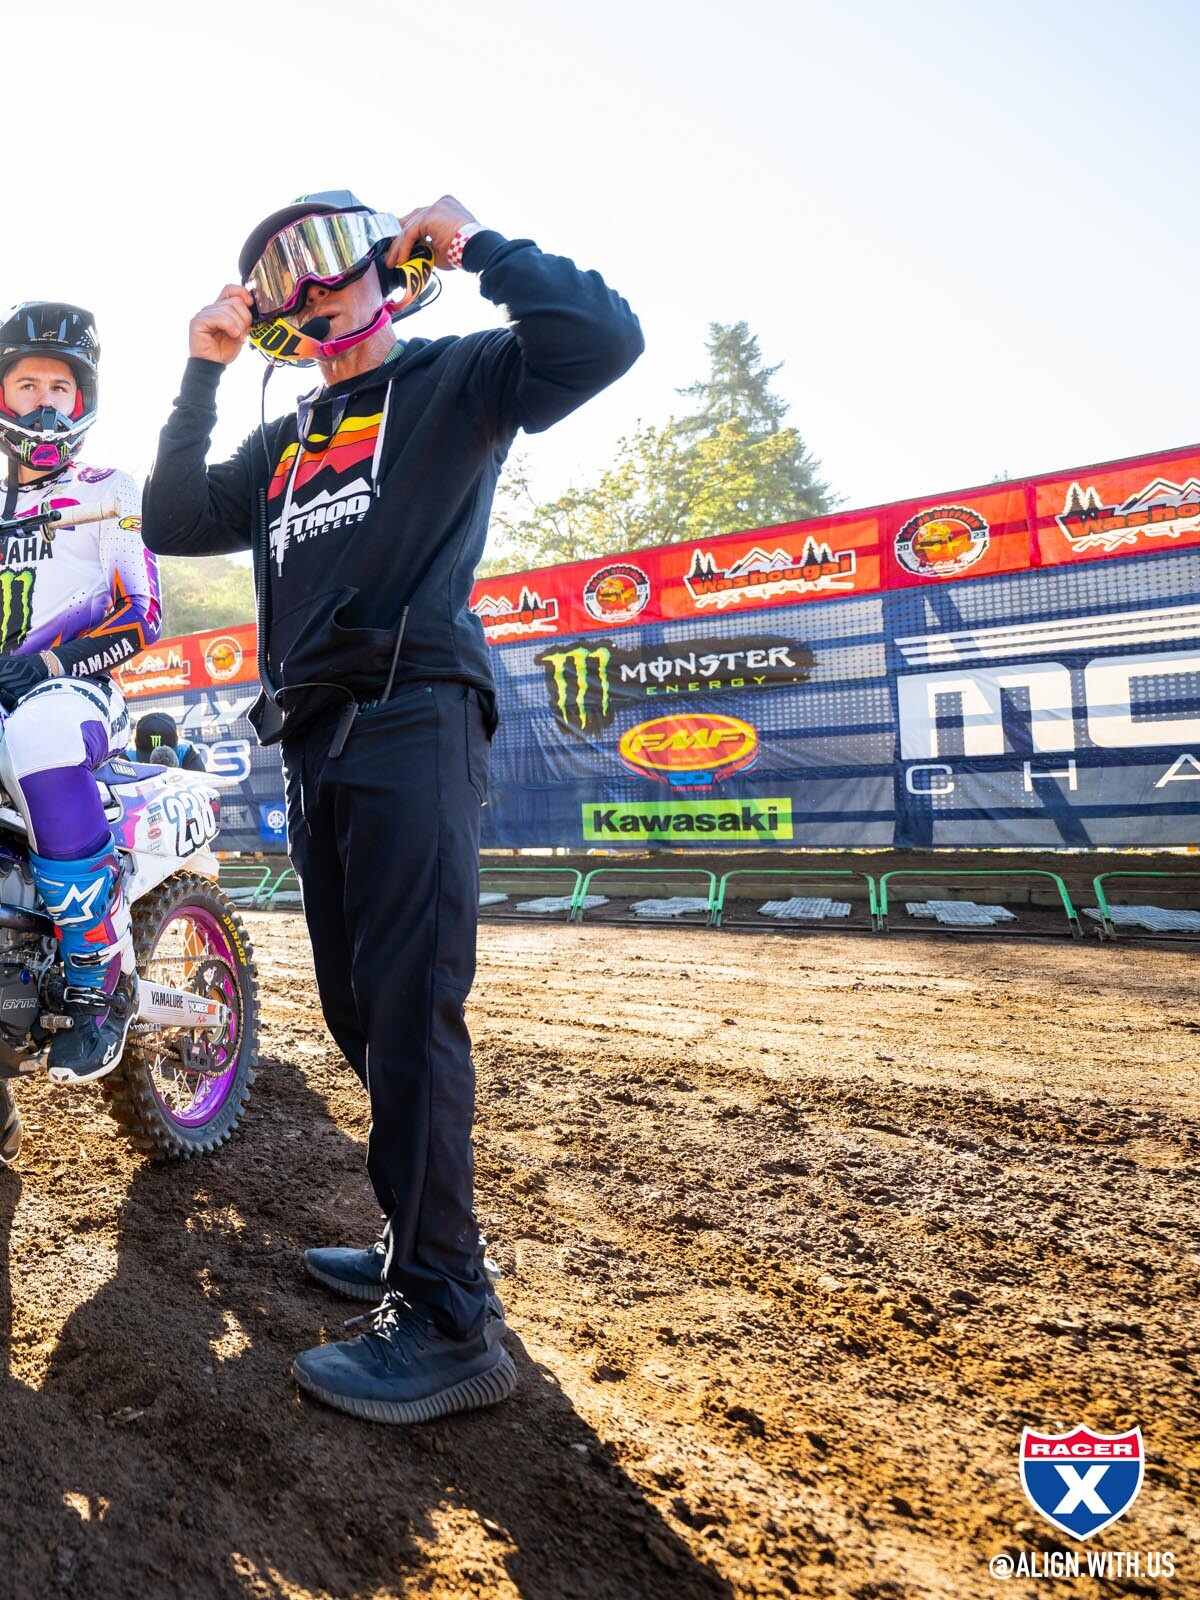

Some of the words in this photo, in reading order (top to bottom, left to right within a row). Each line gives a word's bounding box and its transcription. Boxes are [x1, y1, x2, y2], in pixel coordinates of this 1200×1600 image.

[297, 513, 366, 543] WHEELS
[973, 531, 986, 540] 23
[689, 552, 853, 596] Washougal
[482, 600, 556, 627] hougal
[71, 638, 134, 677] YAMAHA
[646, 675, 766, 695] ENERGY
[629, 728, 745, 753] FMF
[593, 806, 778, 834] Kawasaki
[223, 917, 247, 967] DUNLOP
[151, 990, 184, 1010] YAMALUBE
